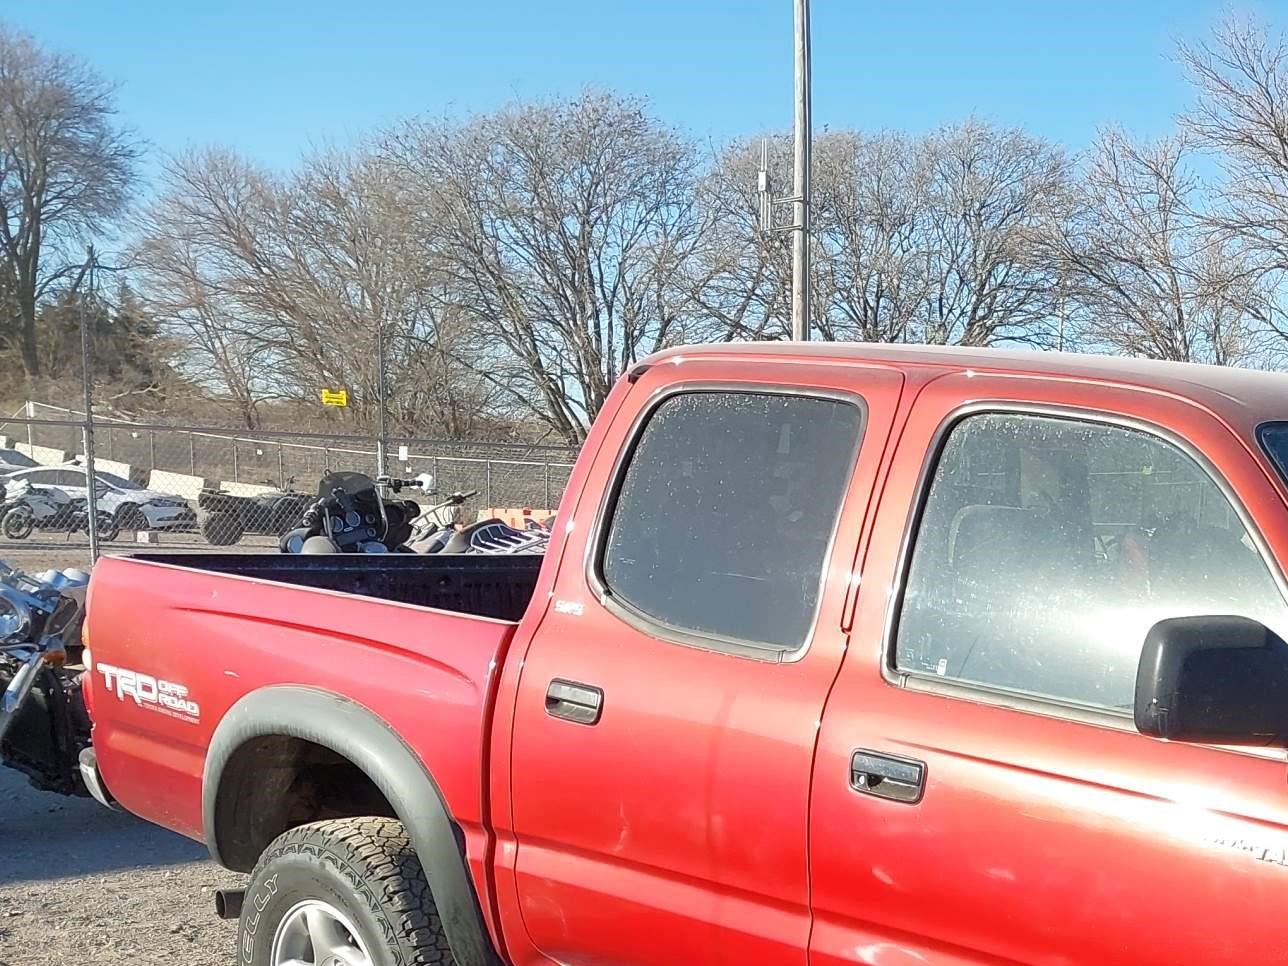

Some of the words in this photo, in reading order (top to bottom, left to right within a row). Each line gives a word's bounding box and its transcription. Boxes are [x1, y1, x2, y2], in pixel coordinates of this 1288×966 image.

[96, 662, 159, 707] TRD
[158, 679, 188, 697] OFF
[158, 692, 200, 717] ROAD
